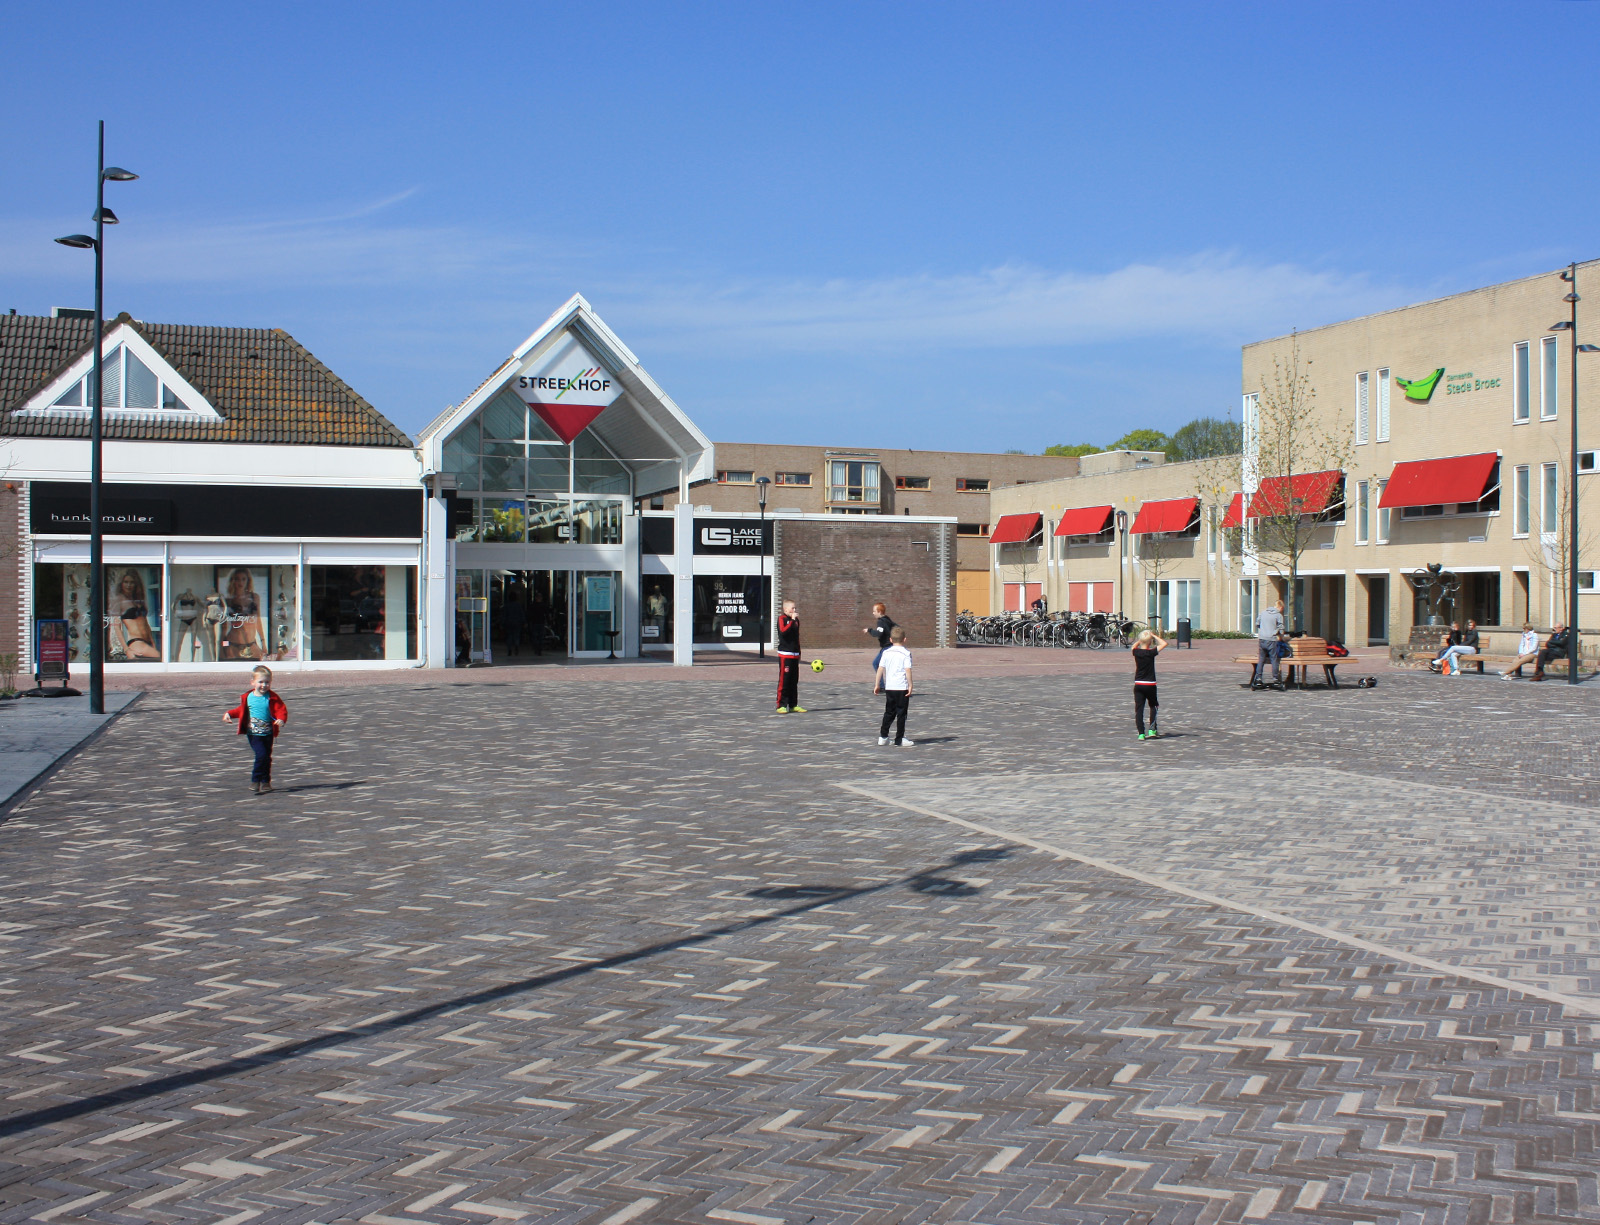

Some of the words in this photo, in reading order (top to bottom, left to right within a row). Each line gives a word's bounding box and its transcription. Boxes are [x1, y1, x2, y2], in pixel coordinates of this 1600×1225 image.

[519, 376, 611, 392] STREEKHOF
[1446, 380, 1472, 395] Stede
[1475, 377, 1501, 391] Broec
[51, 513, 154, 522] hunkmöller
[732, 528, 762, 536] LAKE
[732, 538, 762, 546] SIDE
[720, 605, 738, 613] VOOR
